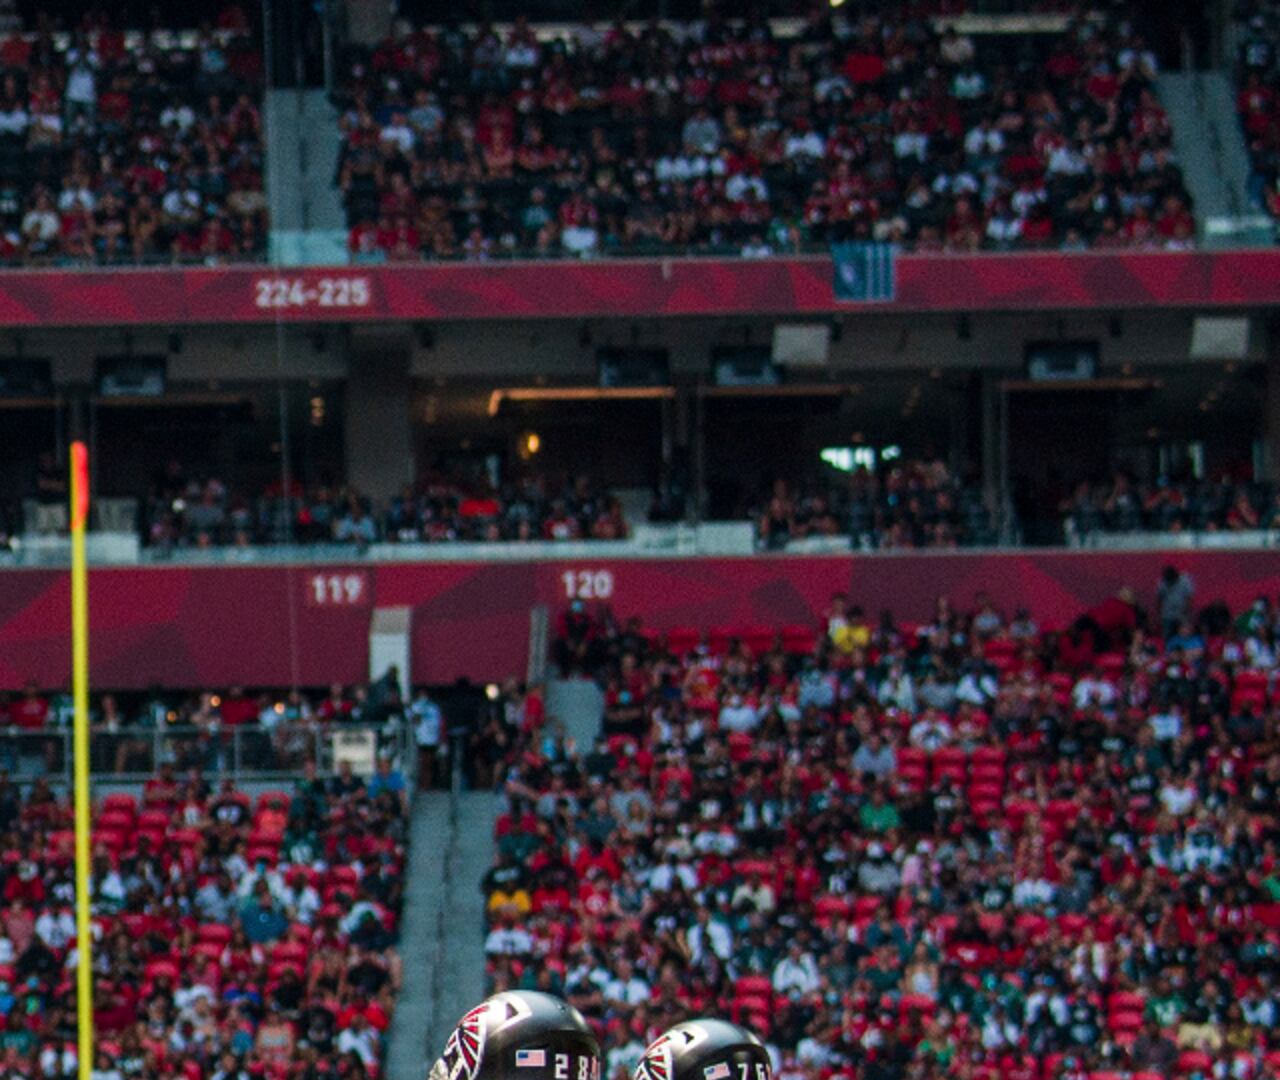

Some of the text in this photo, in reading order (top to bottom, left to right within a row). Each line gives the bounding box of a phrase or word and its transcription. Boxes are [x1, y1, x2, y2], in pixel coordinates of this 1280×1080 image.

[255, 278, 370, 307] 224-225
[312, 575, 363, 603] 119
[562, 569, 613, 599] 120
